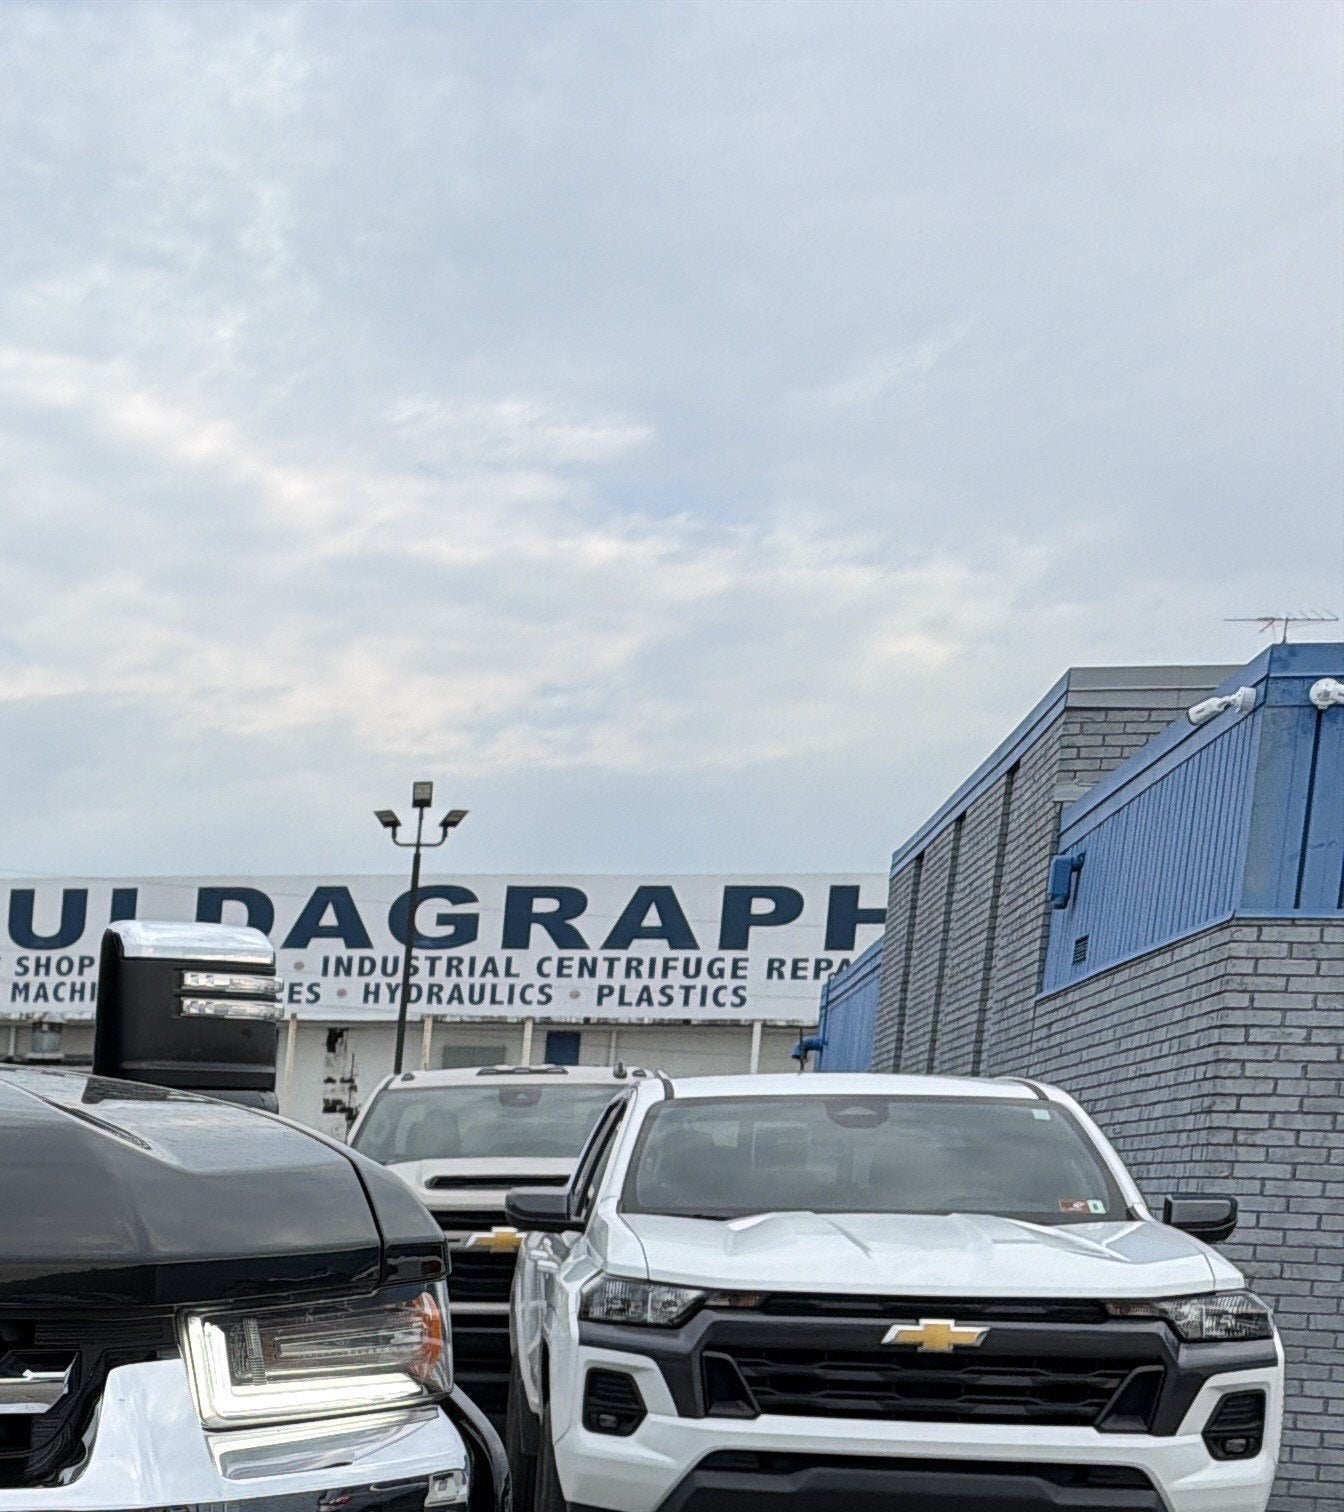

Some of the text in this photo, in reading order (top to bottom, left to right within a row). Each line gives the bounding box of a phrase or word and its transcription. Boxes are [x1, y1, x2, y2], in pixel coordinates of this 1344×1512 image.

[14, 955, 96, 977] SHOP
[321, 955, 852, 981] INDUSTRIAL CENTRIFUGE REPA
[11, 981, 97, 1003] MACHI
[362, 982, 554, 1006] HYDRAULICS
[596, 985, 748, 1007] PLASTICS
